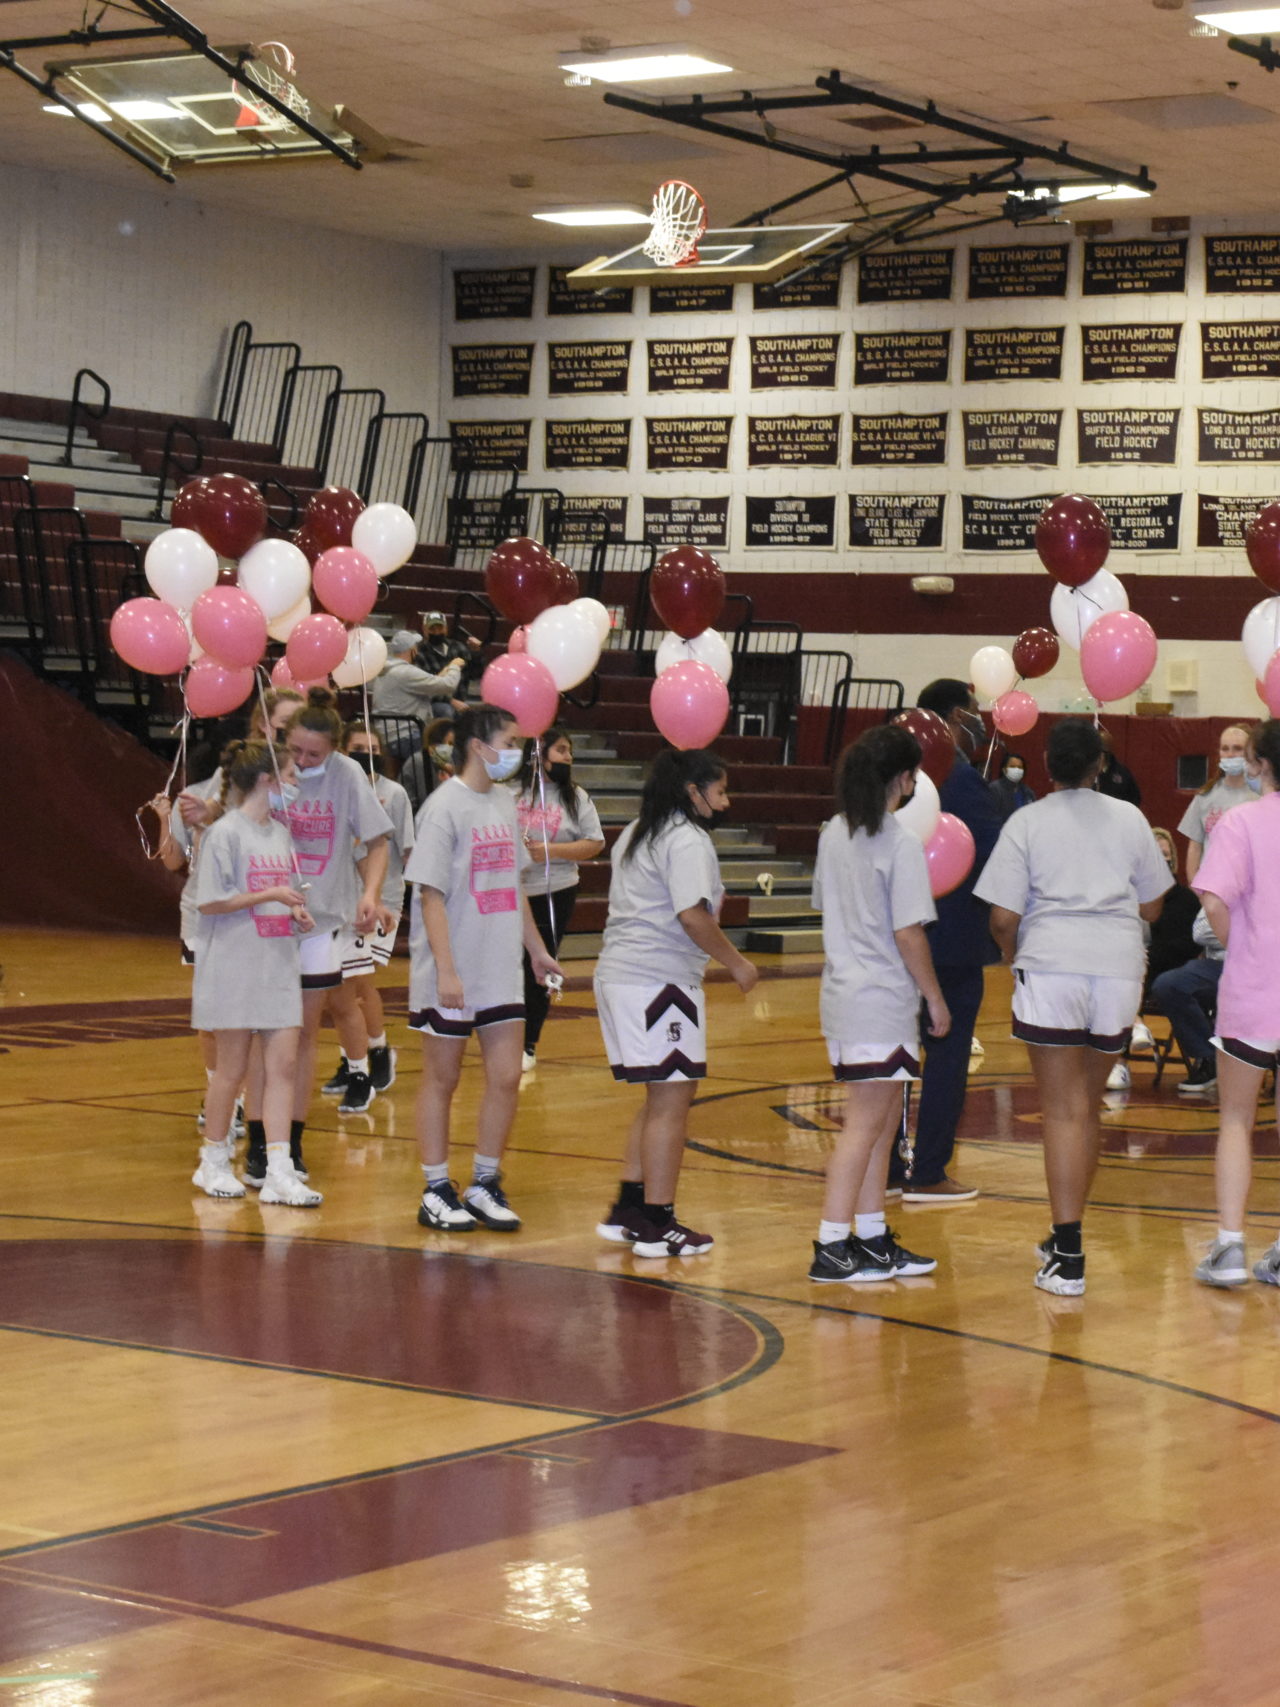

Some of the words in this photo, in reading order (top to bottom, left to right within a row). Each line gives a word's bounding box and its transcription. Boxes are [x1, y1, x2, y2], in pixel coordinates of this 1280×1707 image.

[1095, 244, 1179, 257] SOUTHAMPTON
[867, 254, 946, 267] SOUTHAMPTON
[978, 250, 1061, 263] SOUTHAMPTON
[974, 332, 1056, 344] SOUTHAMPTON
[1089, 328, 1173, 341] SOUTHAMPTON
[757, 339, 833, 351] SOUTHAMPTON
[863, 336, 942, 348] SOUTHAMPTON
[1131, 343, 1176, 352] CHAMPIONS
[458, 349, 527, 360] SOUTHAMPTON
[555, 346, 624, 358] SOUTHAMPTON
[654, 343, 726, 355] SOUTHAMPTON
[1017, 346, 1061, 354] CHAMPIONS
[860, 418, 940, 429] SOUTHAMPTON
[969, 413, 1057, 425] SOUTHAMPTON
[1083, 412, 1174, 424] SOUTHAMPTON
[456, 425, 524, 436] SOUTHAMPTON
[552, 423, 624, 434] SOUTHAMPTON
[653, 422, 726, 432] SOUTHAMPTON
[756, 420, 832, 431] SOUTHAMPTON
[987, 427, 1019, 435] LEAGUE
[1085, 426, 1120, 435] SUFFOLK
[1125, 426, 1170, 435] CHAMPIONS
[1205, 426, 1223, 435] LONG
[1225, 426, 1250, 435] ISLAND
[968, 440, 986, 450] FIELD
[989, 439, 1013, 449] HOCKEY
[1019, 440, 1055, 449] CHAMPIONS
[1096, 437, 1120, 448] FIELD
[1124, 437, 1158, 448] HOCKEY
[1215, 438, 1240, 449] FIELD
[857, 497, 938, 507] SOUTHAMPTON
[770, 513, 798, 521] DIVISION
[1121, 517, 1161, 526] REGIONAL
[865, 519, 888, 527] STATE
[893, 519, 925, 527] FINALIST
[1218, 522, 1240, 530] STATE
[869, 529, 889, 537] FIELD
[893, 529, 921, 537] HOCKEY
[1132, 529, 1165, 538] CHAMPS
[303, 820, 331, 832] CURE
